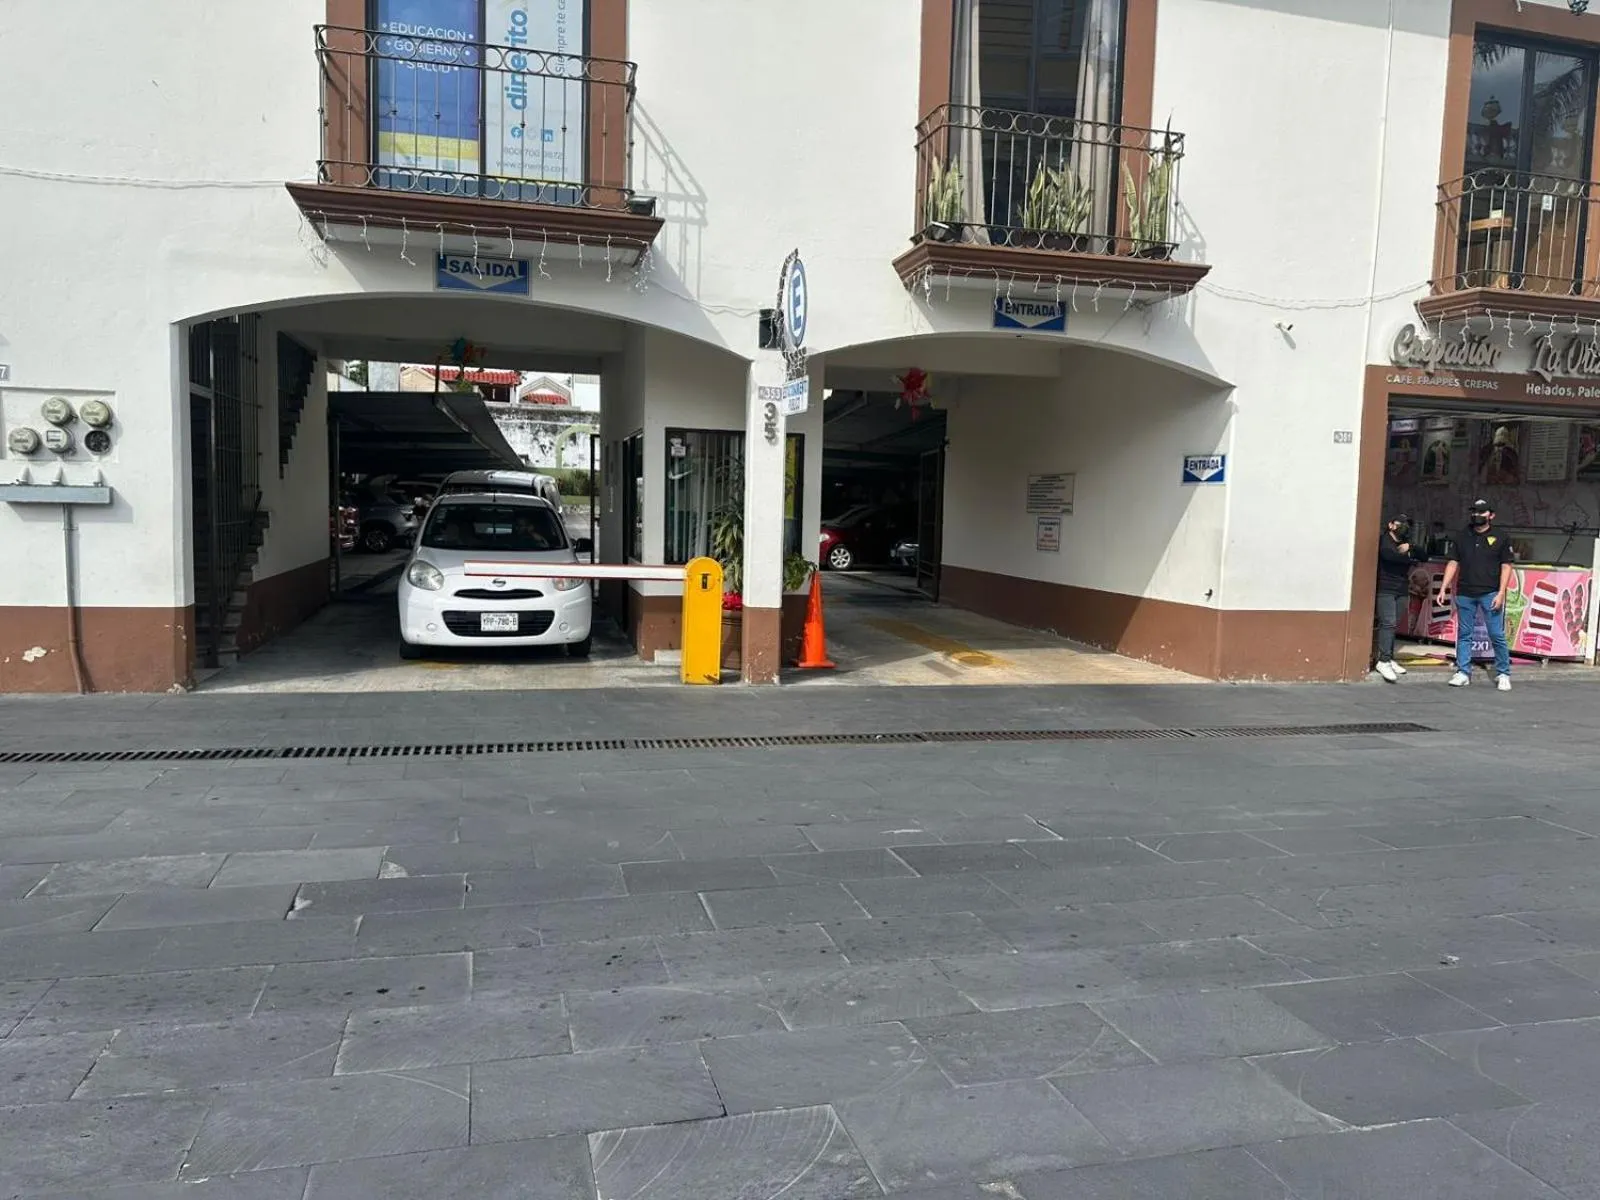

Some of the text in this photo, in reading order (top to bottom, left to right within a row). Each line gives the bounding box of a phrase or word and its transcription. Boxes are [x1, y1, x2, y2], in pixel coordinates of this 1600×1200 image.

[389, 22, 466, 42] EDUCACION
[393, 40, 462, 57] GOIERNO
[504, 9, 528, 110] dineito
[448, 260, 517, 278] SALIDA
[792, 275, 802, 331] E
[1004, 302, 1057, 318] ENTRADA
[1526, 383, 1575, 398] Helados,
[1190, 459, 1219, 470] ENTRADA
[1471, 641, 1489, 651] 2X1
